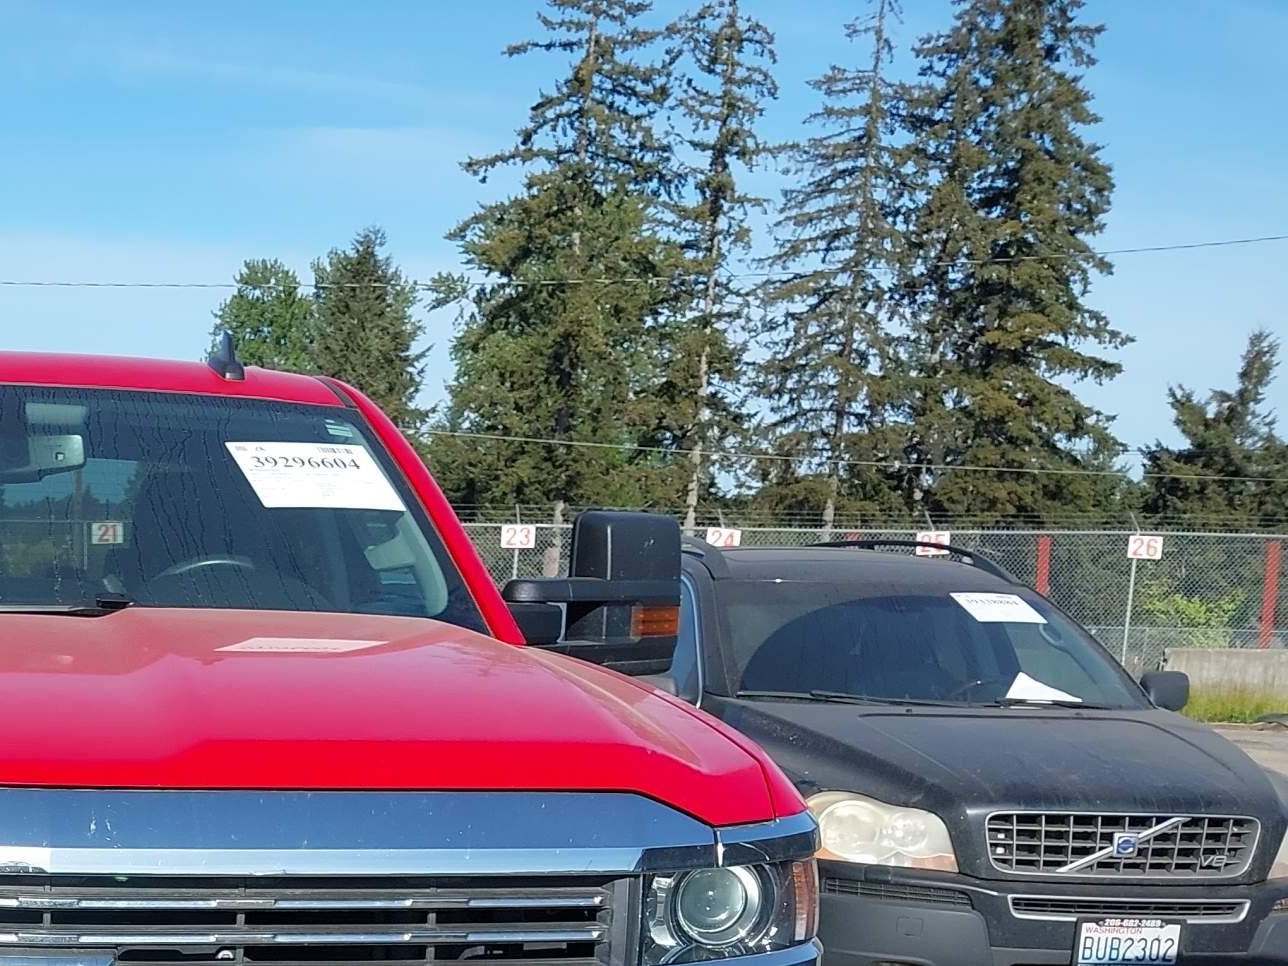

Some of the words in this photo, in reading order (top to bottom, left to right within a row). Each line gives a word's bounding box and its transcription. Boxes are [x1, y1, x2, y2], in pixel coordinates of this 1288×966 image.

[250, 455, 361, 470] 39296604
[97, 523, 119, 543] 21
[505, 527, 531, 546] 23
[712, 530, 734, 547] 24
[1132, 538, 1158, 557] 26
[1085, 926, 1143, 935] WASHINGTON
[1081, 936, 1175, 961] BUB2302
